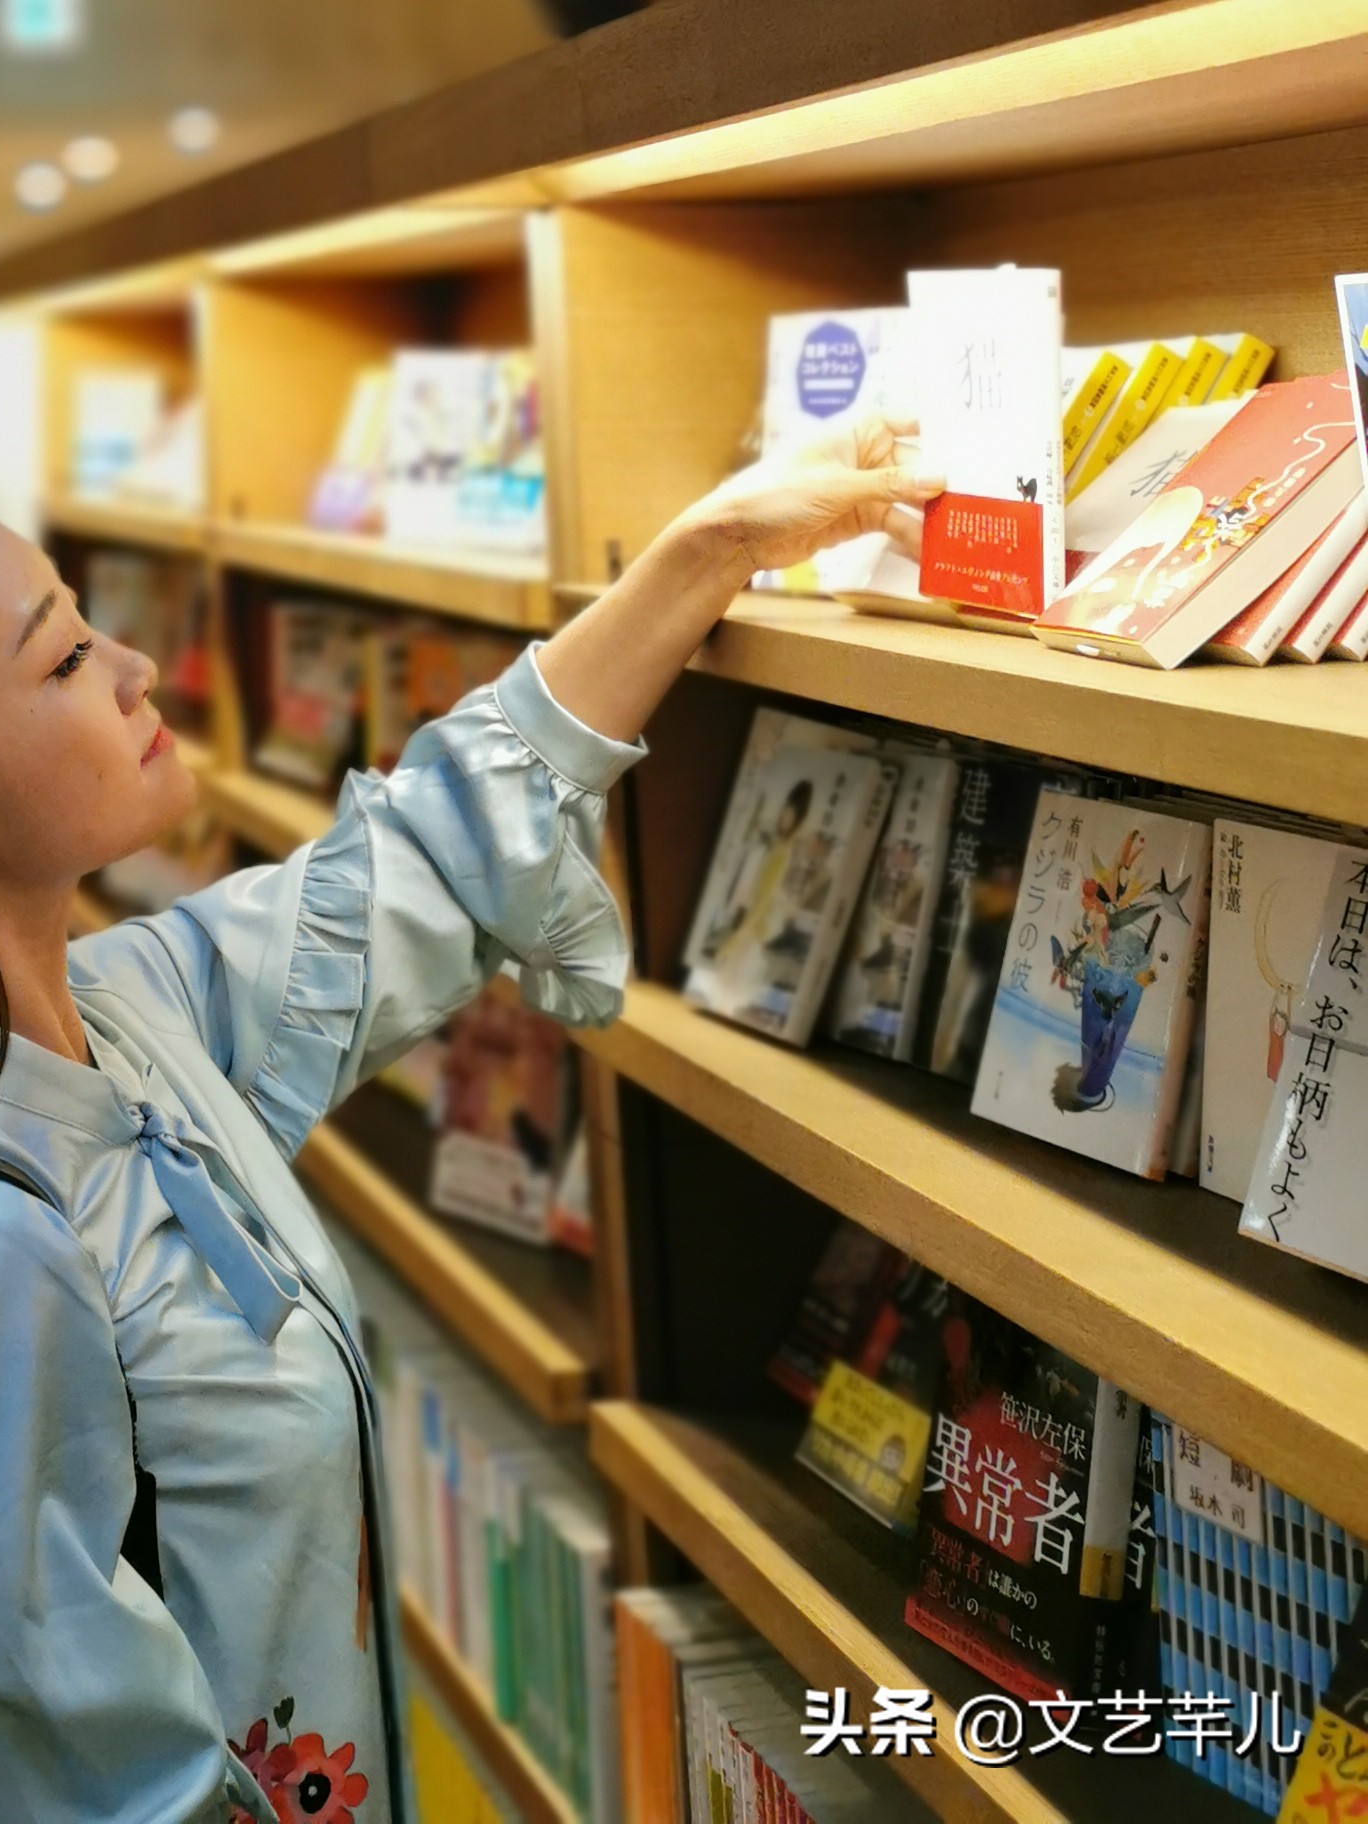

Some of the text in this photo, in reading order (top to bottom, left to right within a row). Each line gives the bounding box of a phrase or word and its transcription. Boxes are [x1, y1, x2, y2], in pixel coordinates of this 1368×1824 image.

[1009, 810, 1063, 993] クジラの彼
[923, 1412, 1085, 1575] 異常者
[999, 1391, 1087, 1461] 笹沢左保
